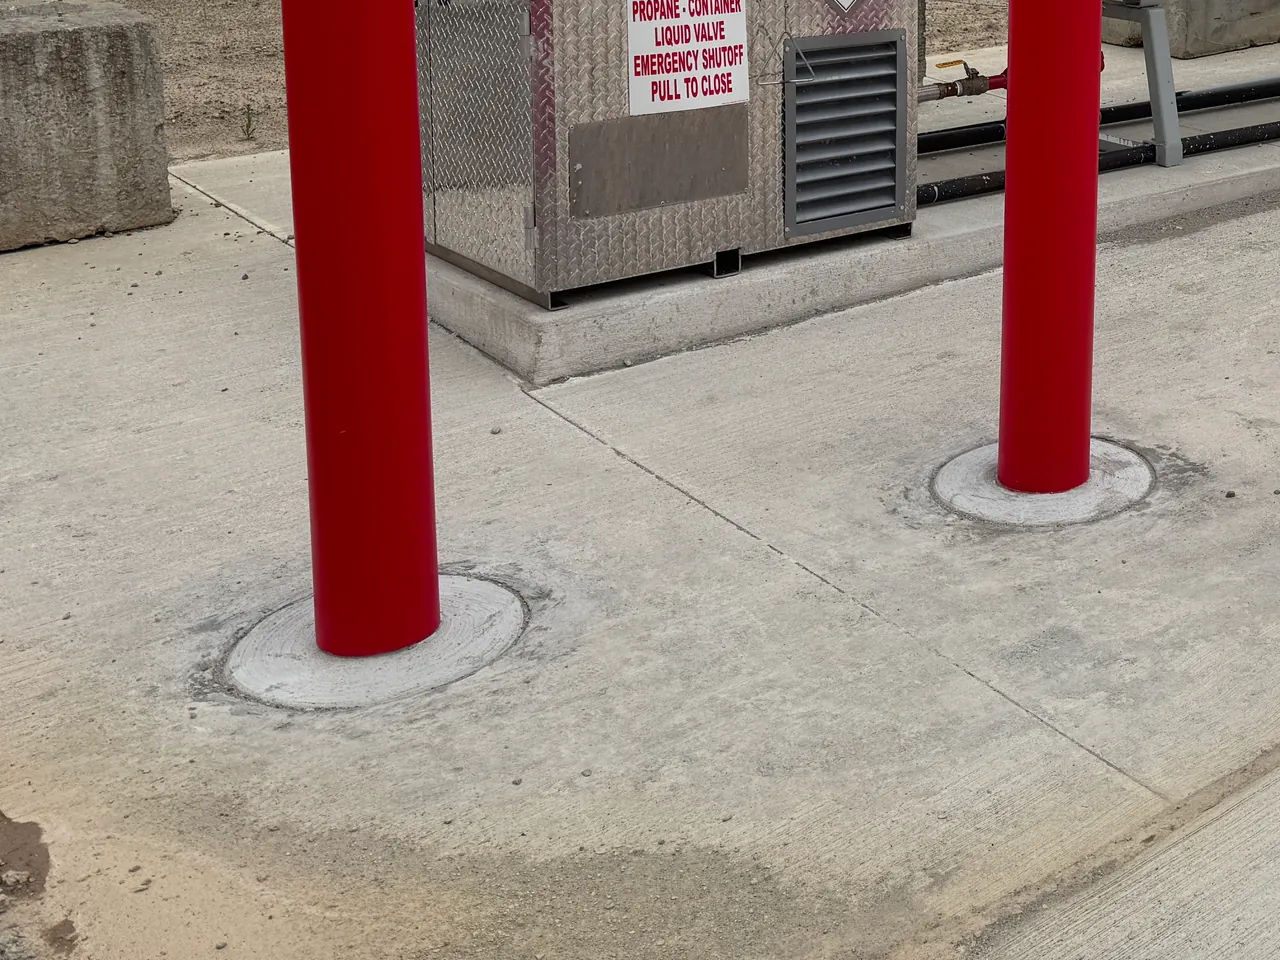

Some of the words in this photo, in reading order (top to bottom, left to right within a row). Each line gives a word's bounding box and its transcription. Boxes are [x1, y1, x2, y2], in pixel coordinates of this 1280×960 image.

[654, 24, 691, 46] LIQUID
[693, 21, 725, 43] VALVE
[634, 50, 699, 76] EMERGENCY
[702, 44, 744, 70] SHUTOFF
[651, 79, 681, 102] PULL
[684, 76, 698, 98] TO
[701, 72, 732, 96] CLOSE
